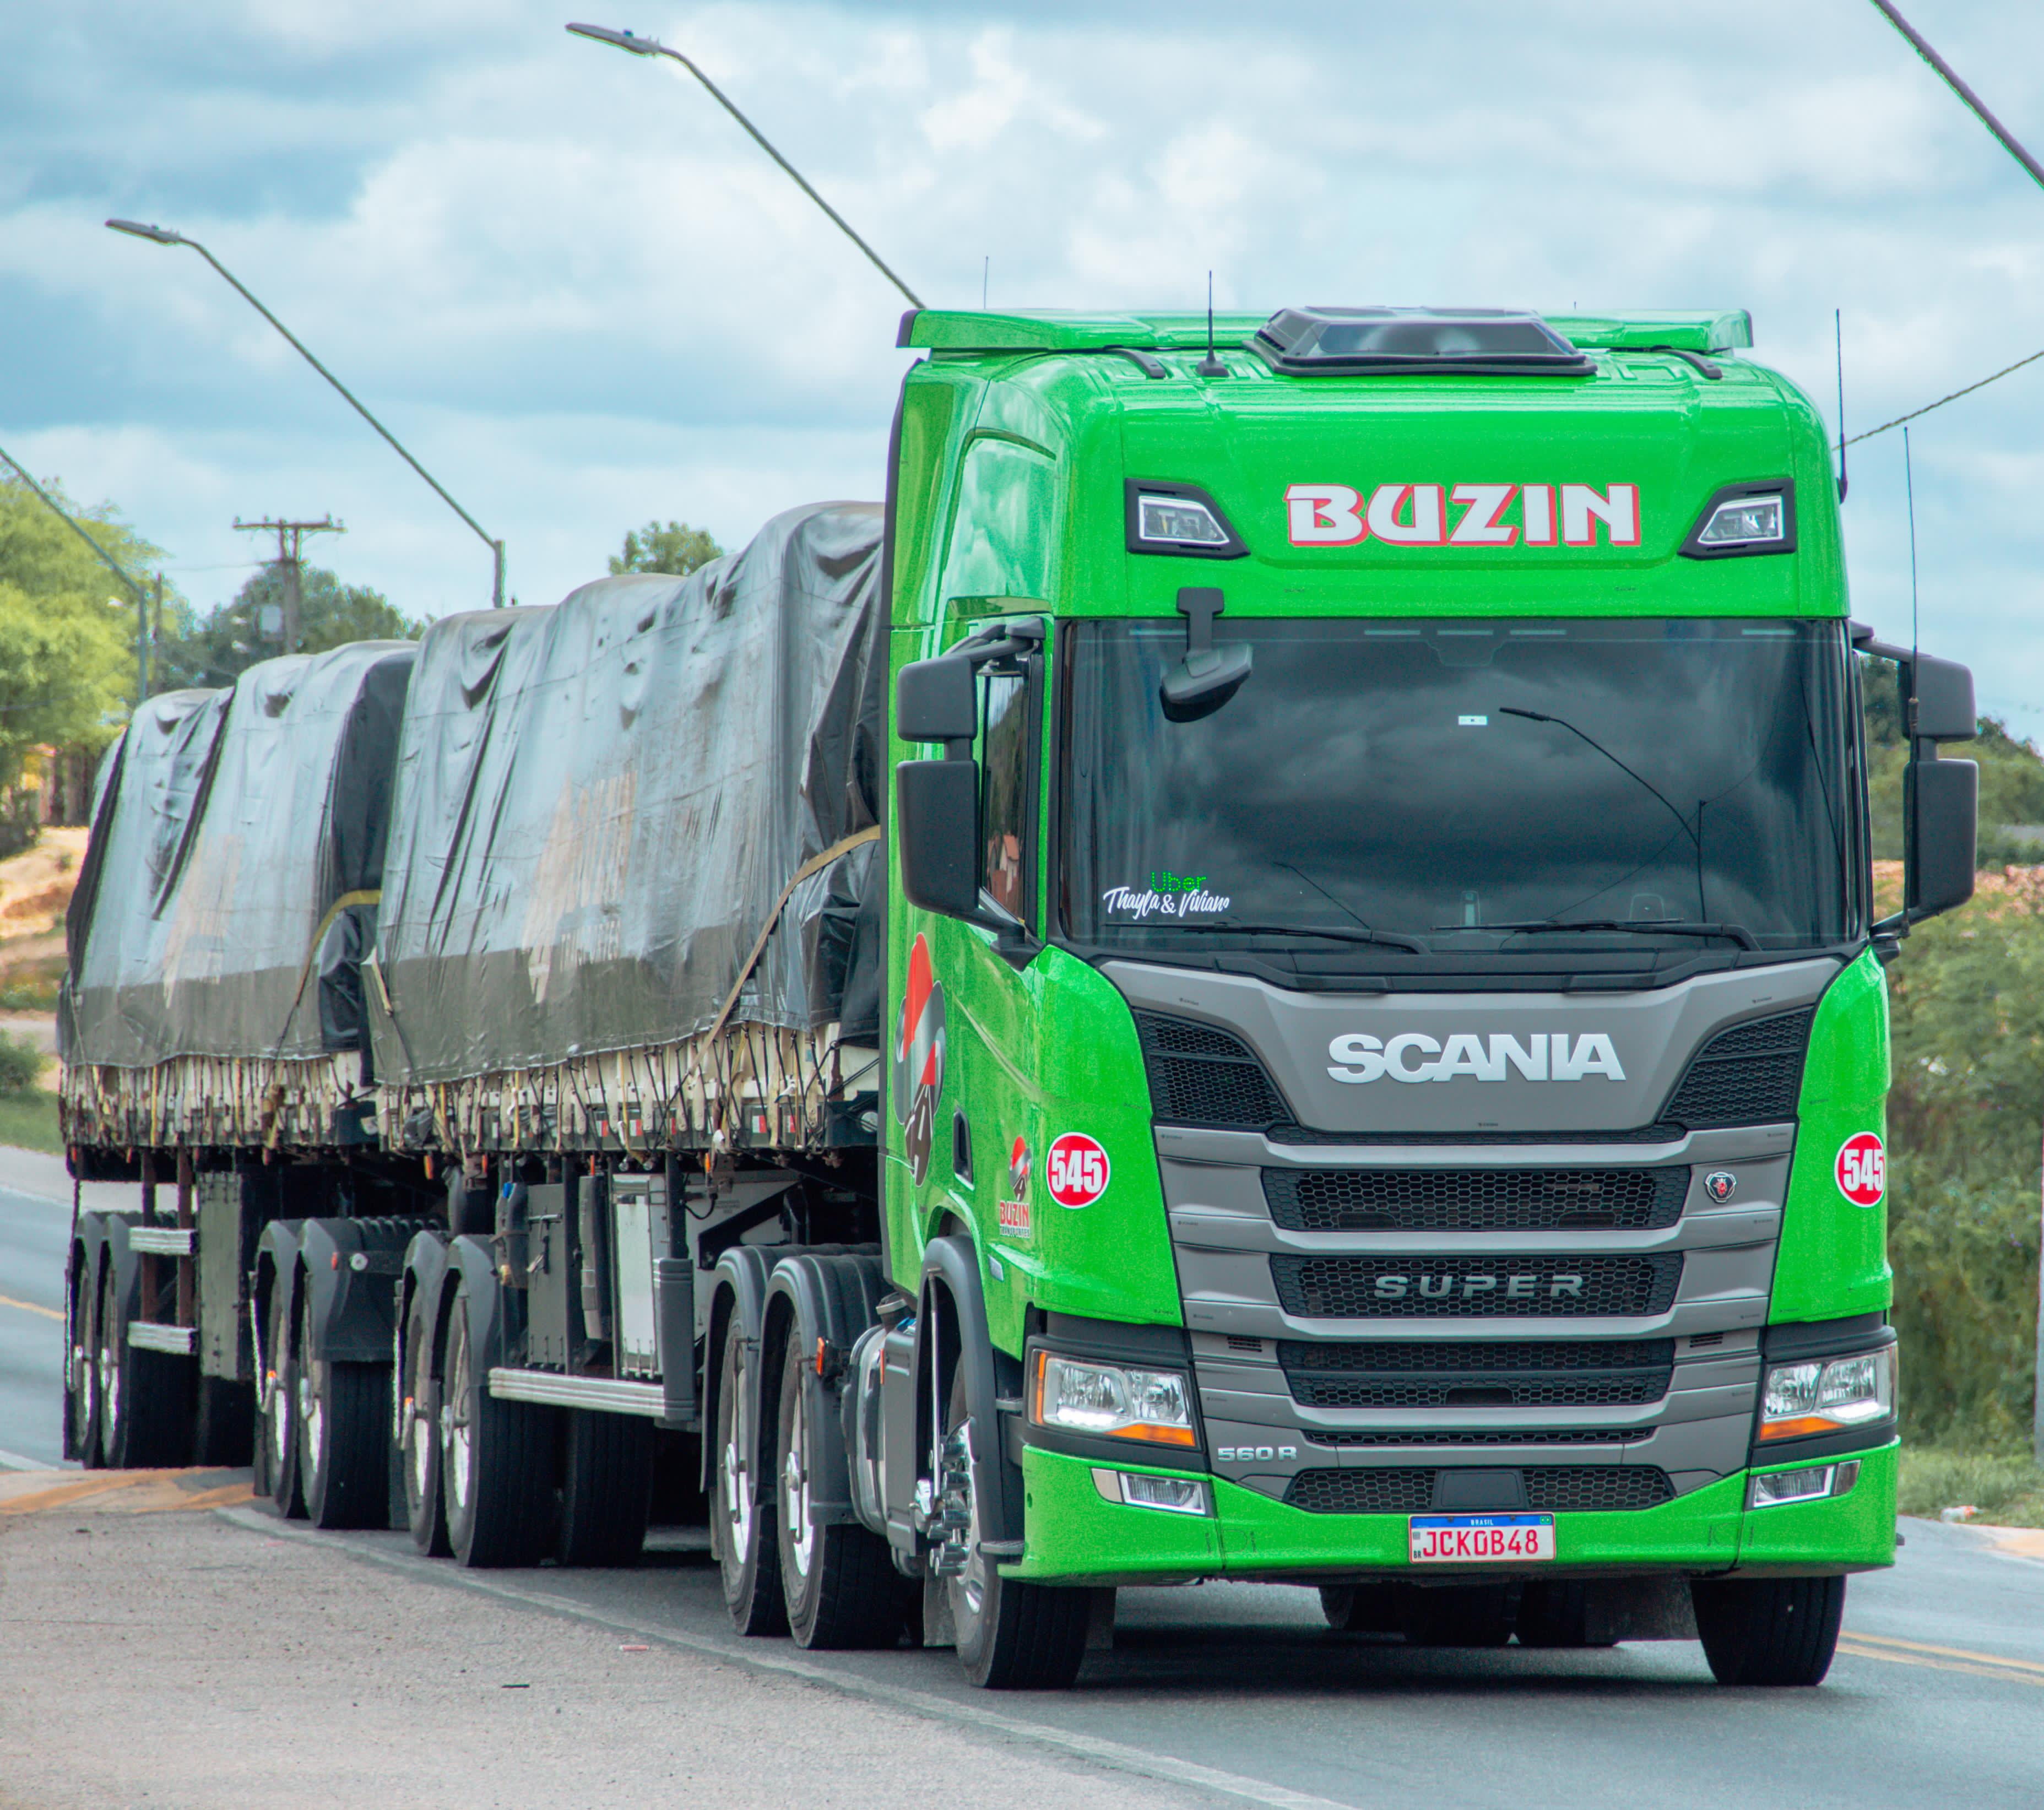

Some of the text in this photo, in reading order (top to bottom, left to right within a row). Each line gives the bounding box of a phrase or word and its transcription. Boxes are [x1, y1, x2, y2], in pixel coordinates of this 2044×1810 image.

[1283, 483, 1641, 546] BUZIN
[1151, 871, 1207, 892] Uber
[1103, 886, 1160, 920] Thayla
[1161, 894, 1176, 913] &
[1326, 1033, 1626, 1083] SCANIA
[1051, 1150, 1102, 1193] 545
[1843, 1149, 1885, 1191] 545
[1000, 1201, 1029, 1228] BUZIN
[1374, 1275, 1582, 1298] SUPER
[1217, 1446, 1297, 1462] 560 R
[1413, 1550, 1422, 1559] BR
